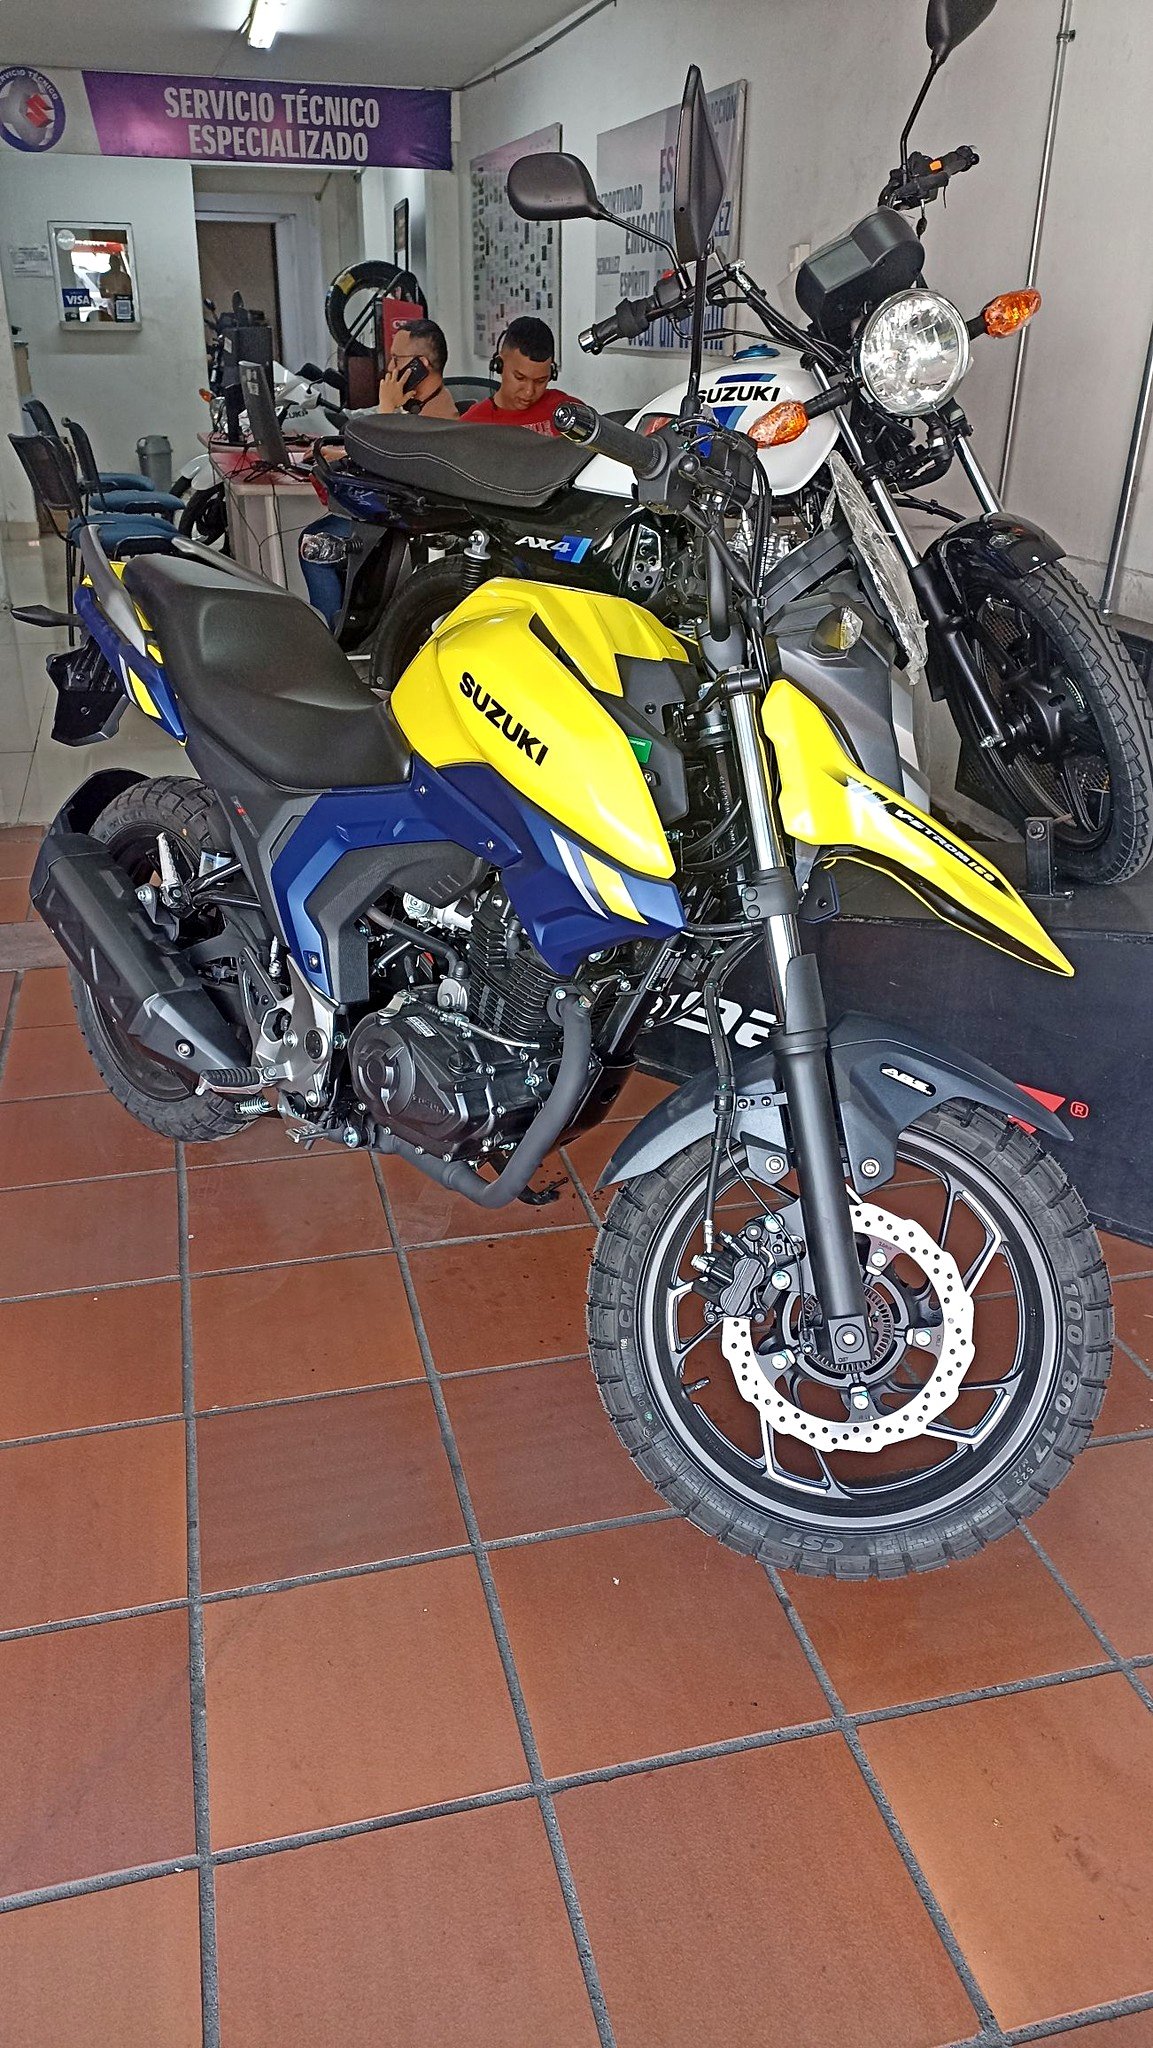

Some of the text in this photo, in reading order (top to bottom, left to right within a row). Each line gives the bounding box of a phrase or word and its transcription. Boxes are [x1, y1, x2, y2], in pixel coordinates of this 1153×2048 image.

[164, 87, 380, 128] SERVICIO TÉCNICO
[188, 124, 369, 161] ESPECIALIZADO
[66, 295, 91, 305] VISA
[698, 386, 780, 404] SUZUKI
[514, 536, 572, 553] AX4
[459, 671, 549, 767] SUZUKI
[880, 1067, 933, 1096] ABS
[1033, 1282, 1083, 1464] 100/80-17
[781, 1531, 844, 1554] CST
